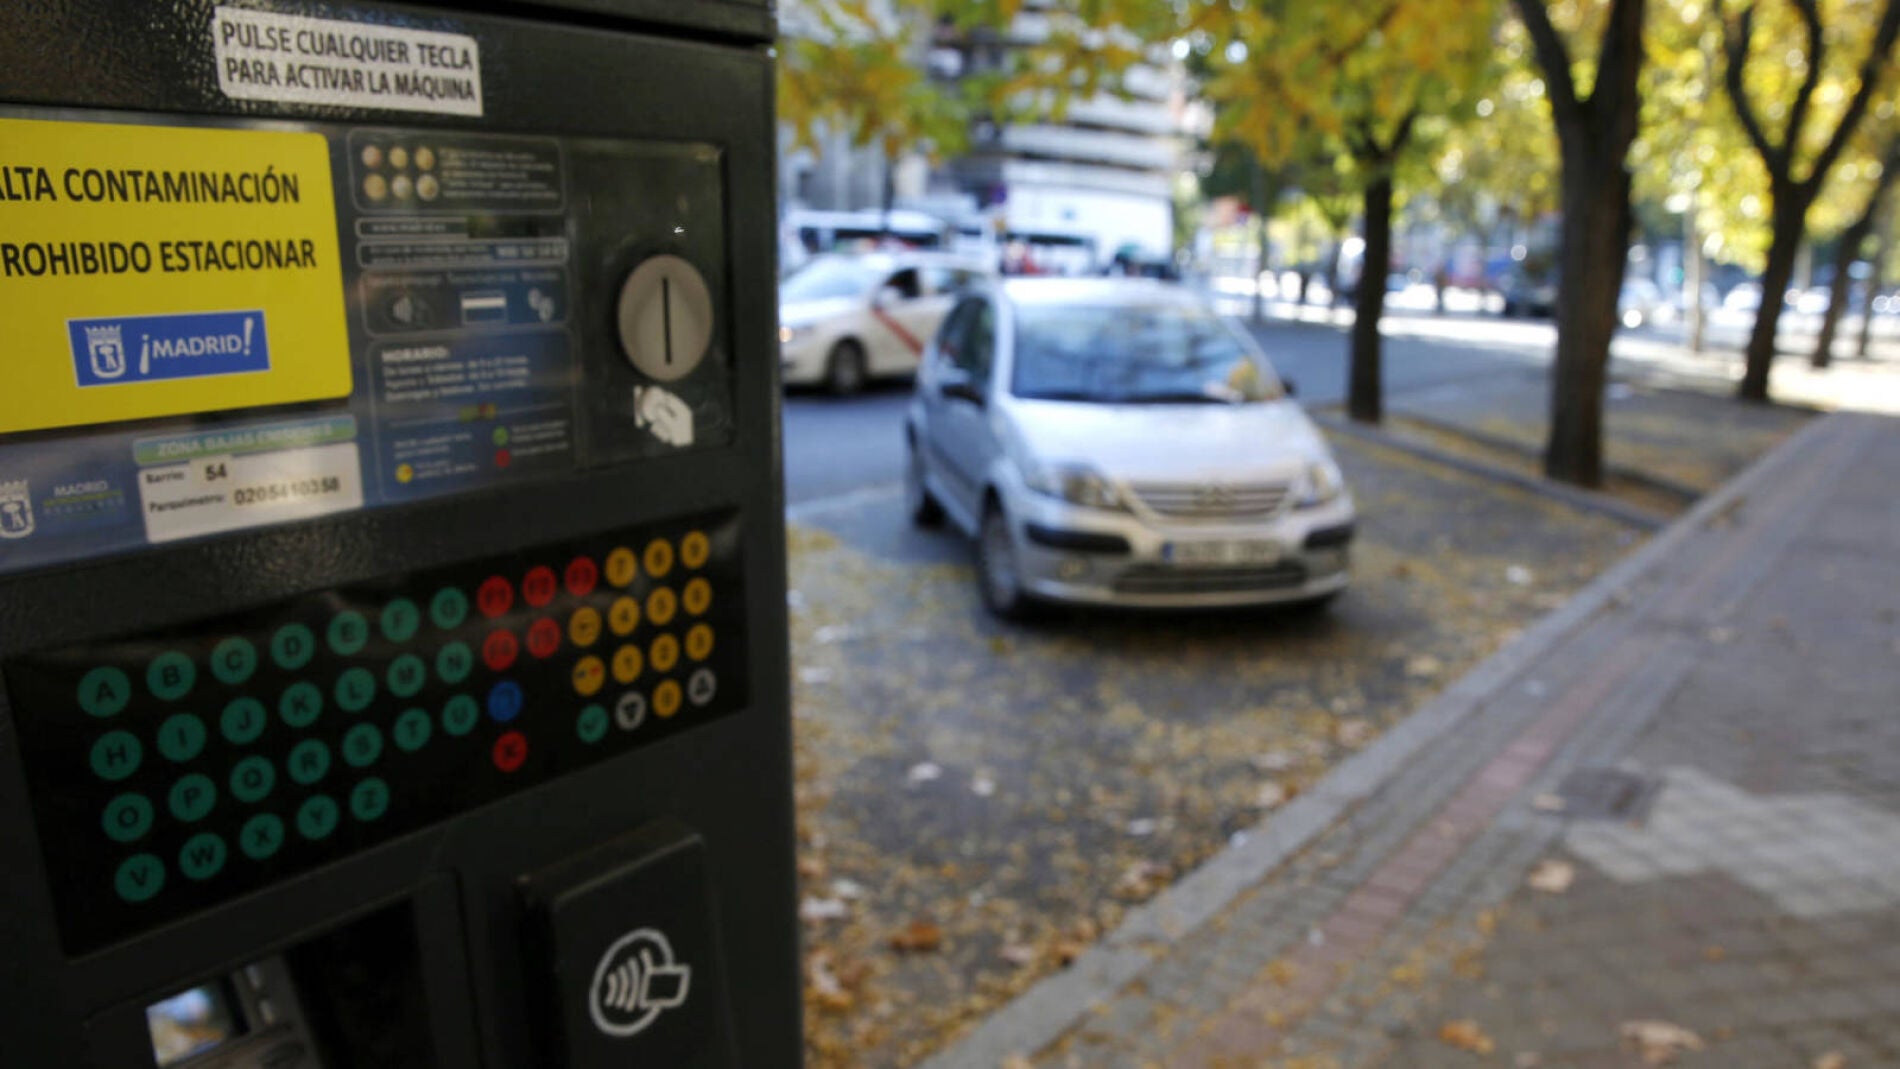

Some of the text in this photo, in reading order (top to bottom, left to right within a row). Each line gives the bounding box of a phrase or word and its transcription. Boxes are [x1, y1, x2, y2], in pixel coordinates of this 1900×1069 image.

[221, 21, 472, 70] PULSE CUALQUIER TECLA
[226, 58, 475, 101] PARA ACTIVAR LA MÁQUINA
[64, 164, 300, 203] CONTAMINACIÓN
[0, 239, 317, 277] ROHIBIDO ESTACIONAR
[139, 317, 254, 374] ¡MADRID!
[158, 438, 200, 457] ZONA
[54, 480, 108, 496] MADRID
[206, 463, 227, 481] 54
[95, 681, 116, 703] A
[163, 666, 181, 687] B
[226, 651, 244, 671] C
[285, 637, 301, 657] D
[342, 623, 356, 643] E
[107, 745, 127, 765] H
[178, 729, 186, 747] I
[238, 713, 251, 731] J
[293, 695, 309, 713] K
[348, 680, 362, 700] L
[446, 655, 462, 672] N
[119, 807, 138, 826] O
[185, 788, 202, 807] P
[301, 752, 318, 771] R
[405, 722, 419, 739] T
[132, 869, 148, 887] V
[192, 848, 215, 866] W
[255, 829, 270, 845] X
[311, 809, 324, 826] Y
